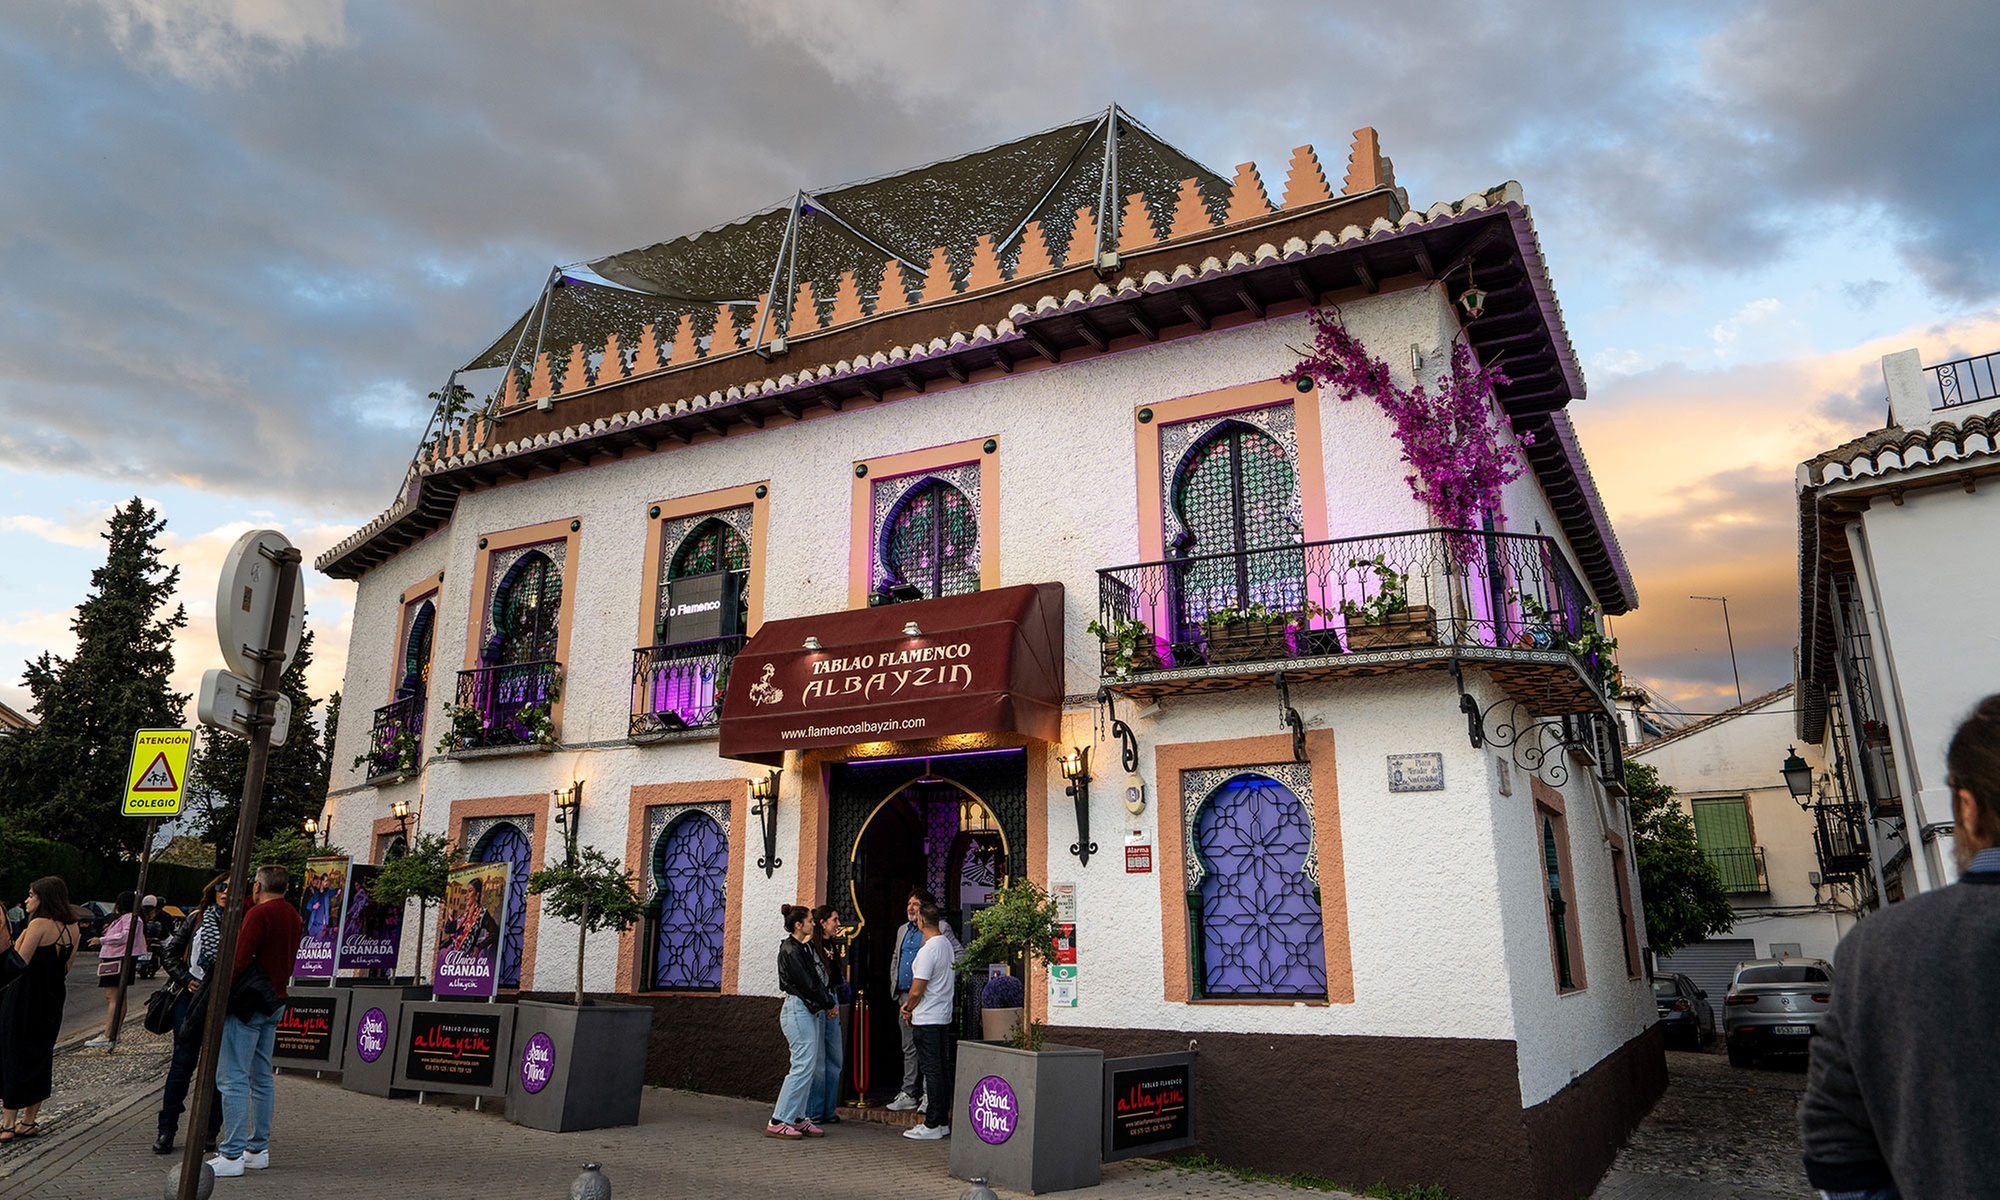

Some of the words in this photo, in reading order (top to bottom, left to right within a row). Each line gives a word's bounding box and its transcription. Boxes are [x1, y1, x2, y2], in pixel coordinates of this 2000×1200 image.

[677, 600, 721, 616] Flamenco
[812, 654, 874, 675] TABLAO
[878, 643, 971, 667] FLAMENCO
[802, 664, 972, 707] ALBAYZIN
[781, 717, 926, 740] www.flamencoalbayzin.com
[138, 736, 189, 745] ATENCIÓN
[129, 799, 176, 808] COLEGIO
[296, 949, 332, 959] GRANADA
[341, 945, 394, 955] GRANADA
[478, 957, 488, 966] en
[440, 964, 490, 977] GRANADA
[463, 1026, 490, 1034] FLAMENCO
